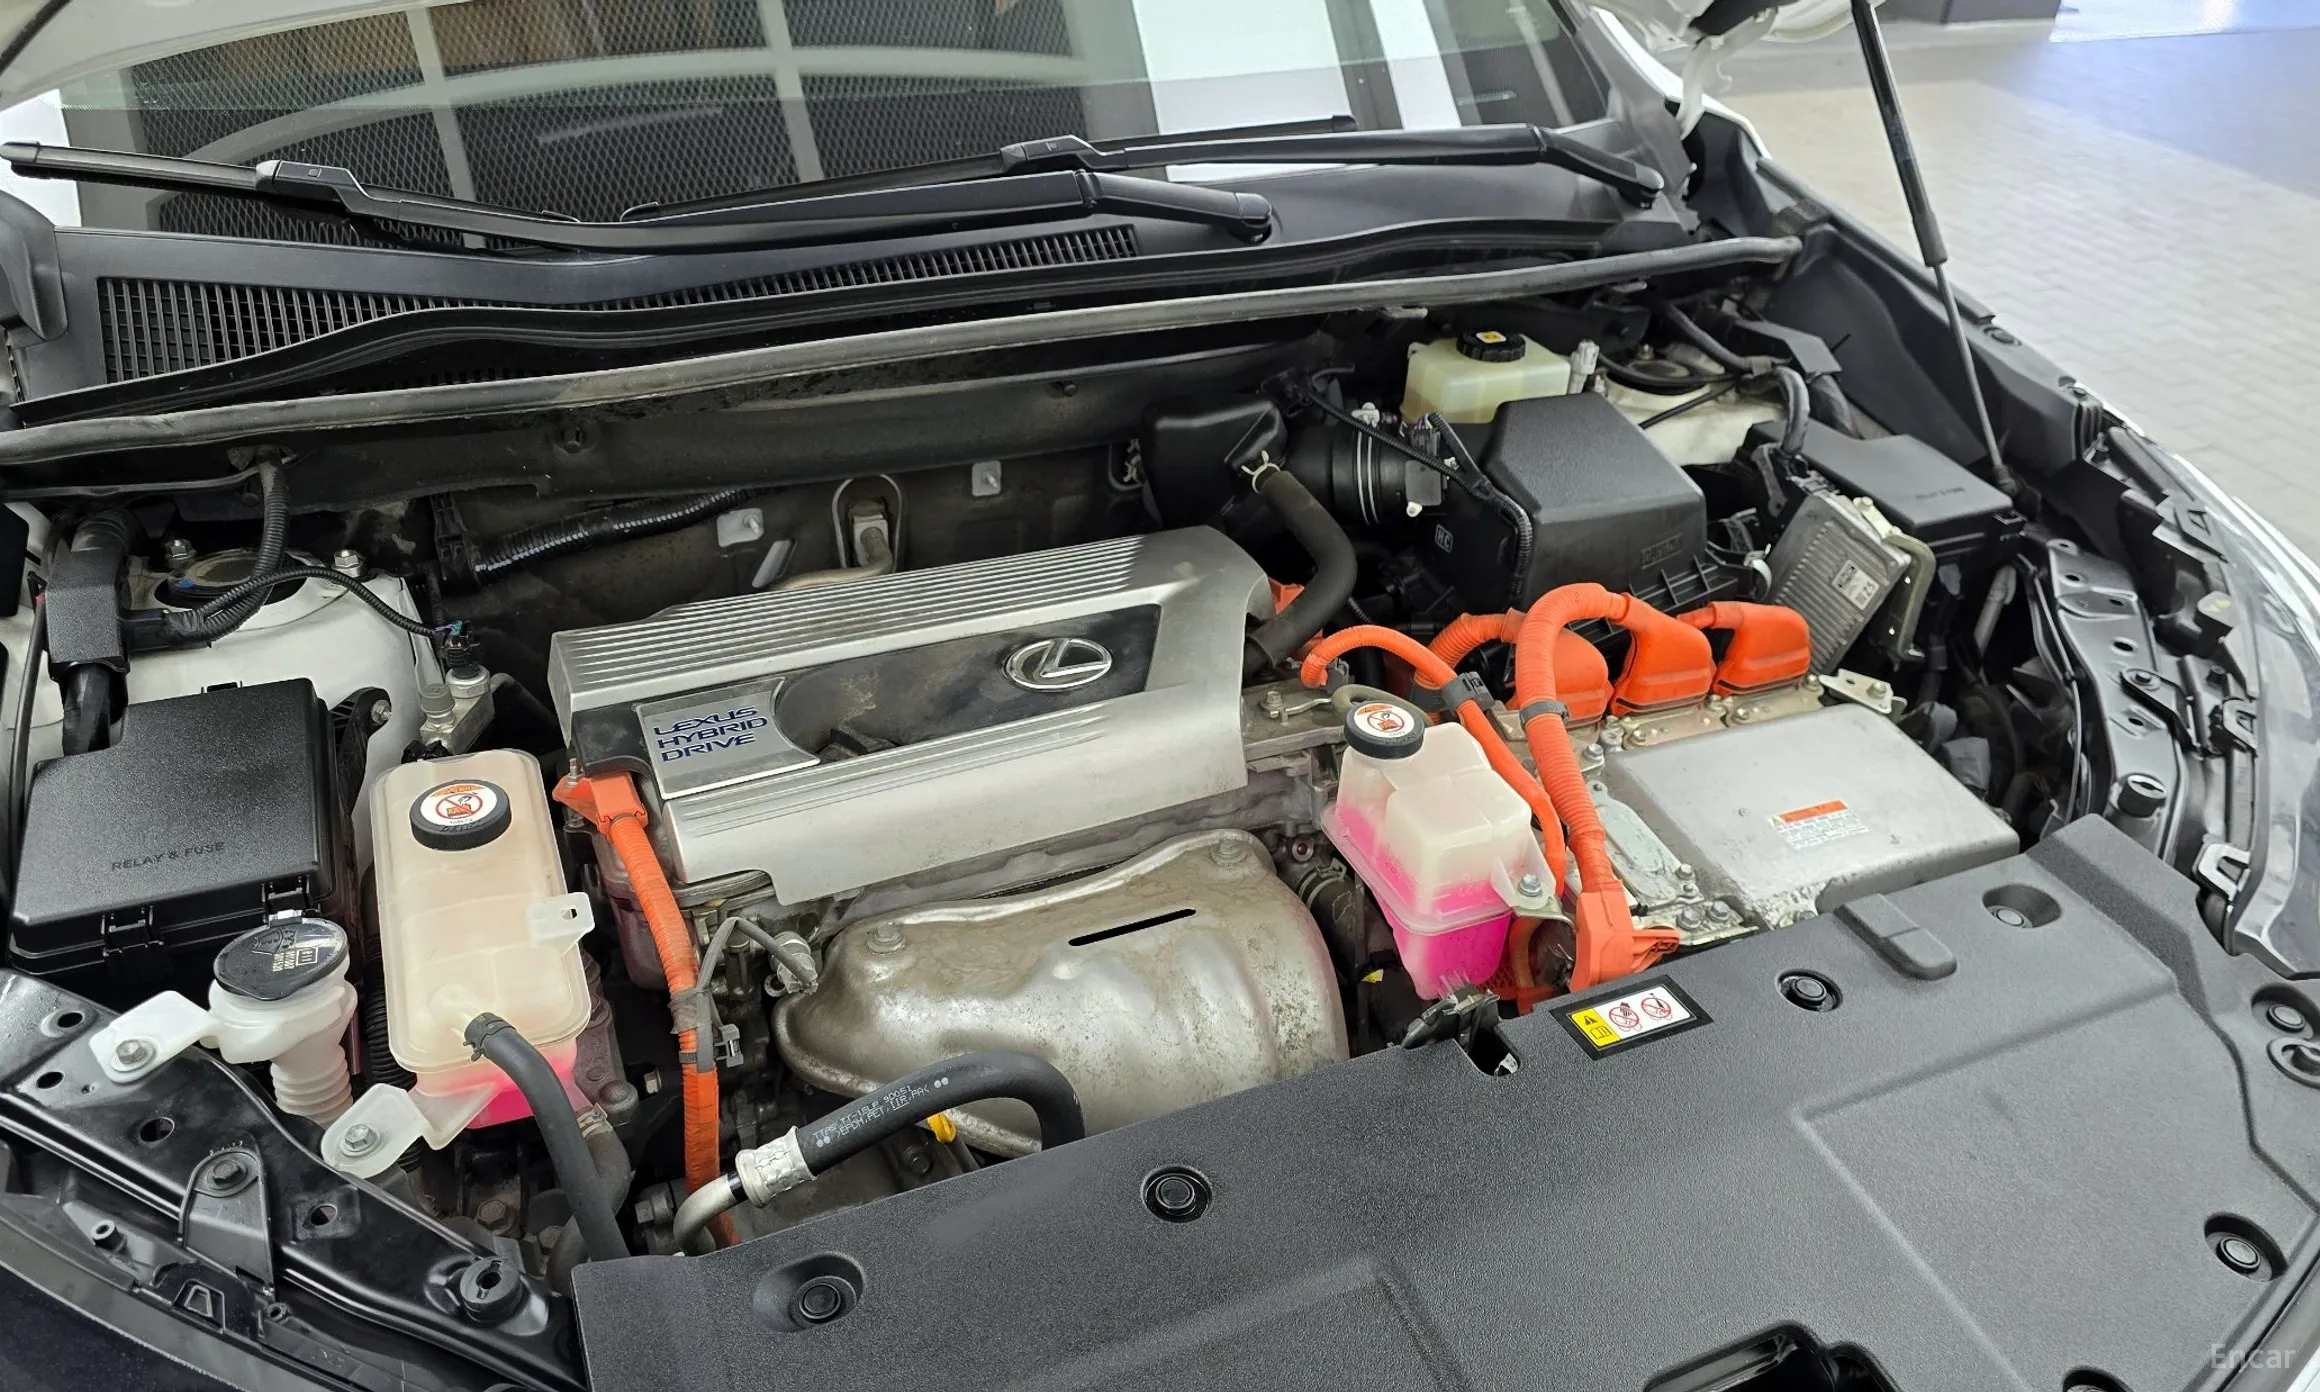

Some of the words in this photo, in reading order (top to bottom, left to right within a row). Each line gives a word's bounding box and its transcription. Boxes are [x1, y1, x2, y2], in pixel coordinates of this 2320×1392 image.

[654, 706, 759, 735] LEXUS
[658, 717, 768, 748] HYBRID
[661, 733, 756, 762] DRIVE
[111, 852, 165, 872] RELAY
[184, 841, 225, 858] FUSE
